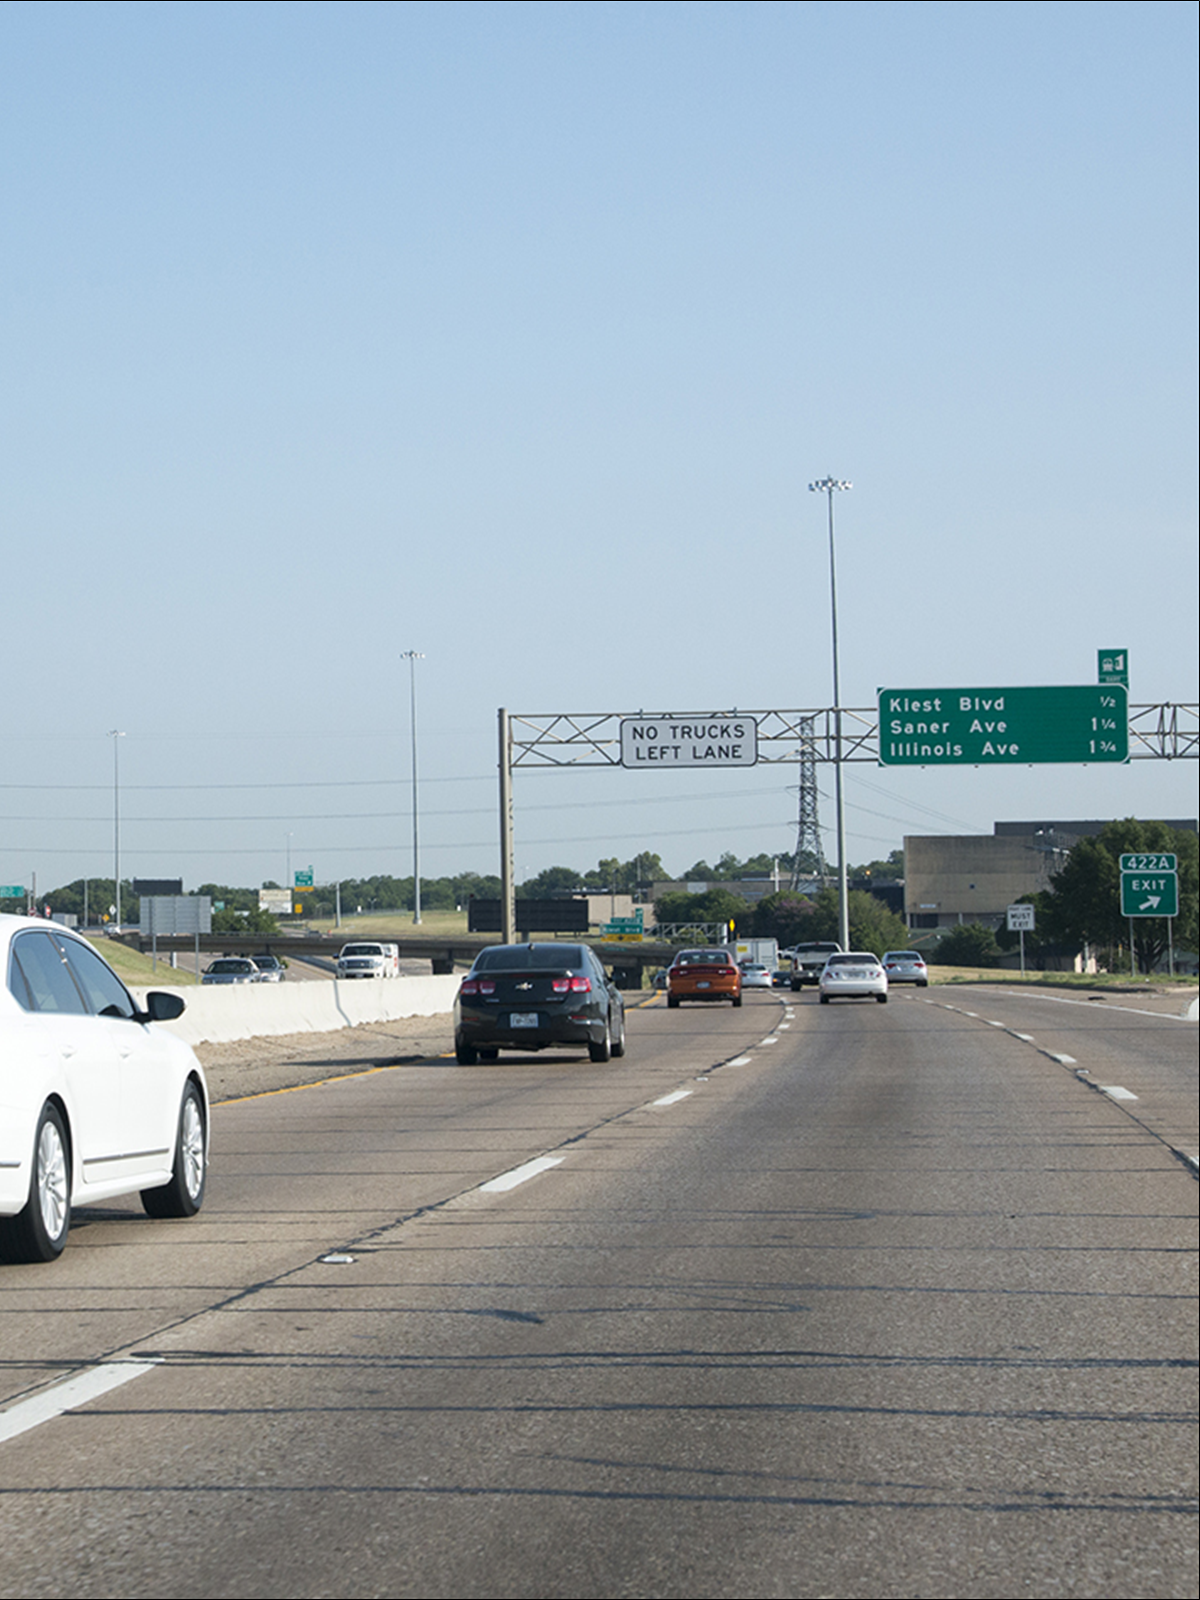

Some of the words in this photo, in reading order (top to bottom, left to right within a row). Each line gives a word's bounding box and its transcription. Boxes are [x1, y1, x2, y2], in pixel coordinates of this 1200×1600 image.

[960, 697, 1004, 711] Blvd
[633, 726, 658, 740] NO
[670, 725, 745, 739] TRUCKS
[891, 720, 950, 734] Saner
[969, 719, 1007, 733] Ave
[636, 746, 681, 760] LEFT
[693, 745, 742, 759] LANE
[891, 742, 962, 756] Illinois
[982, 742, 1019, 755] Ave
[1127, 856, 1169, 869] 422A
[1132, 880, 1166, 890] EXIT
